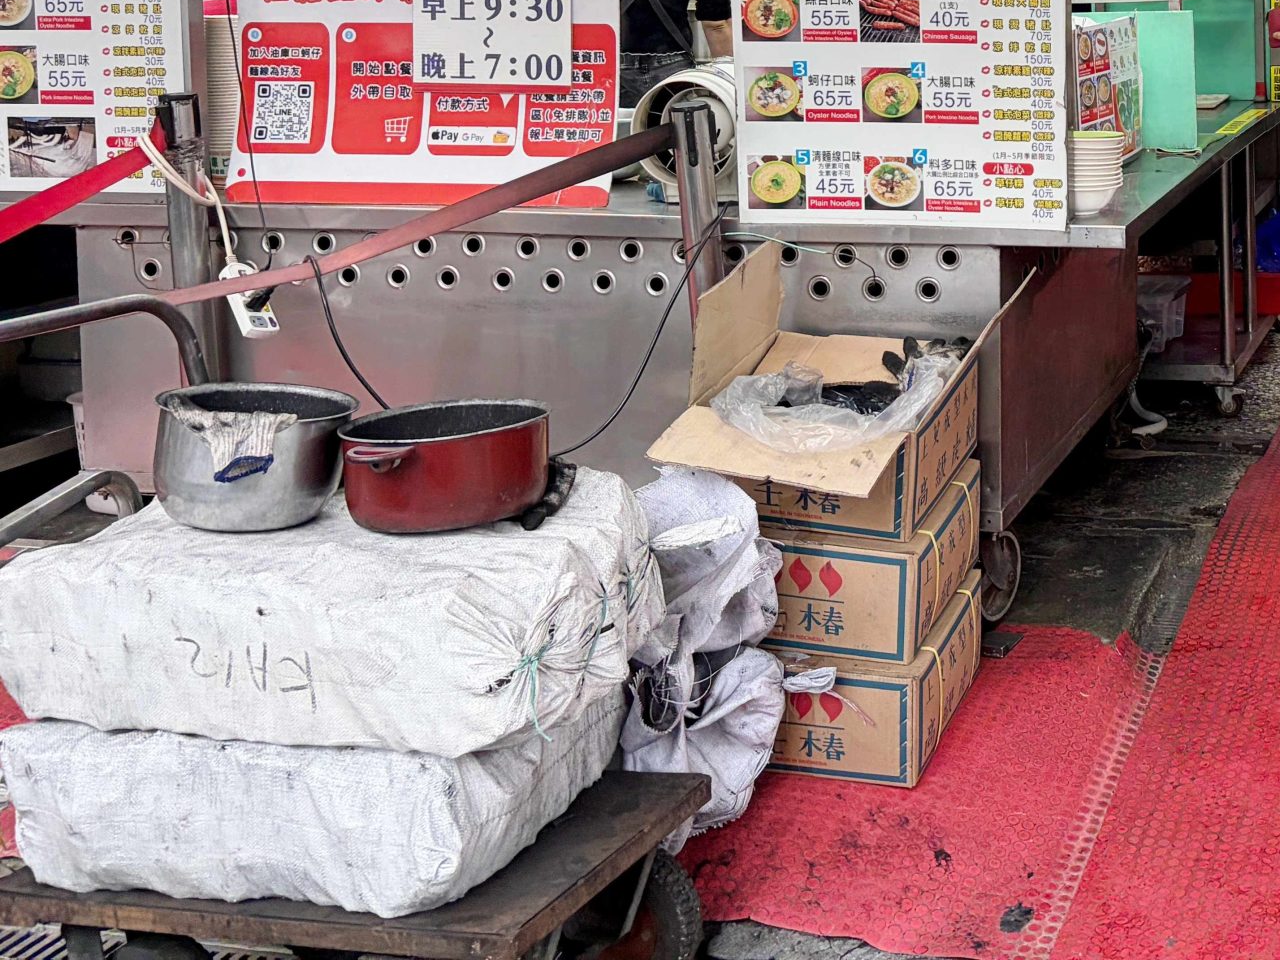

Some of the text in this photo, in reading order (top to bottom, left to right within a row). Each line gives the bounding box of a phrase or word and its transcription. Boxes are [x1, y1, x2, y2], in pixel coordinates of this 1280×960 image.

[143, 15, 162, 23] 70元
[811, 10, 850, 26] 55元
[929, 11, 969, 27] 40元
[1029, 9, 1050, 18] 70元
[139, 36, 163, 45] 150元
[949, 33, 976, 41] Sausage
[1030, 31, 1051, 41] 70元
[248, 48, 322, 60] 加入油庫口蚵仔
[1025, 55, 1052, 64] 150元
[42, 54, 90, 67] 大腸口味
[145, 57, 164, 65] 30元
[113, 68, 146, 77] 台式泡菜
[248, 66, 301, 77] 麵線為好友
[352, 62, 412, 76] 開始點餐
[794, 62, 805, 75] 3
[912, 64, 924, 77] 4
[48, 70, 86, 87] 55元
[146, 78, 165, 86] 40元
[808, 74, 856, 87] 蚵仔口味
[927, 76, 975, 88] 大腸口味
[1031, 77, 1052, 86] 30元
[114, 87, 146, 97] 韓式泡菜
[351, 85, 412, 99] 外帶自取
[993, 87, 1031, 98] 台式泡菜
[813, 90, 853, 106] 65元
[932, 92, 971, 107] 55元
[437, 97, 490, 111] 付款方式
[1030, 100, 1052, 109] 40元
[530, 109, 612, 122] 區(免排隊)並
[808, 112, 829, 120] Oyster
[994, 109, 1031, 120] 韓式泡菜
[1031, 121, 1052, 130] 50元
[441, 130, 459, 142] Pay
[529, 128, 602, 141] 報上單號即可
[1031, 143, 1053, 152] 60元
[798, 151, 810, 164] 5
[812, 151, 861, 162] 清麵線口味
[914, 150, 925, 163] 6
[928, 159, 977, 171] 料多口味
[993, 163, 1024, 174] 小點心
[816, 179, 854, 194] 45元
[934, 181, 973, 197] 65元
[1032, 189, 1053, 198] 40元
[827, 200, 860, 208] Noodles
[1032, 209, 1053, 218] 40元
